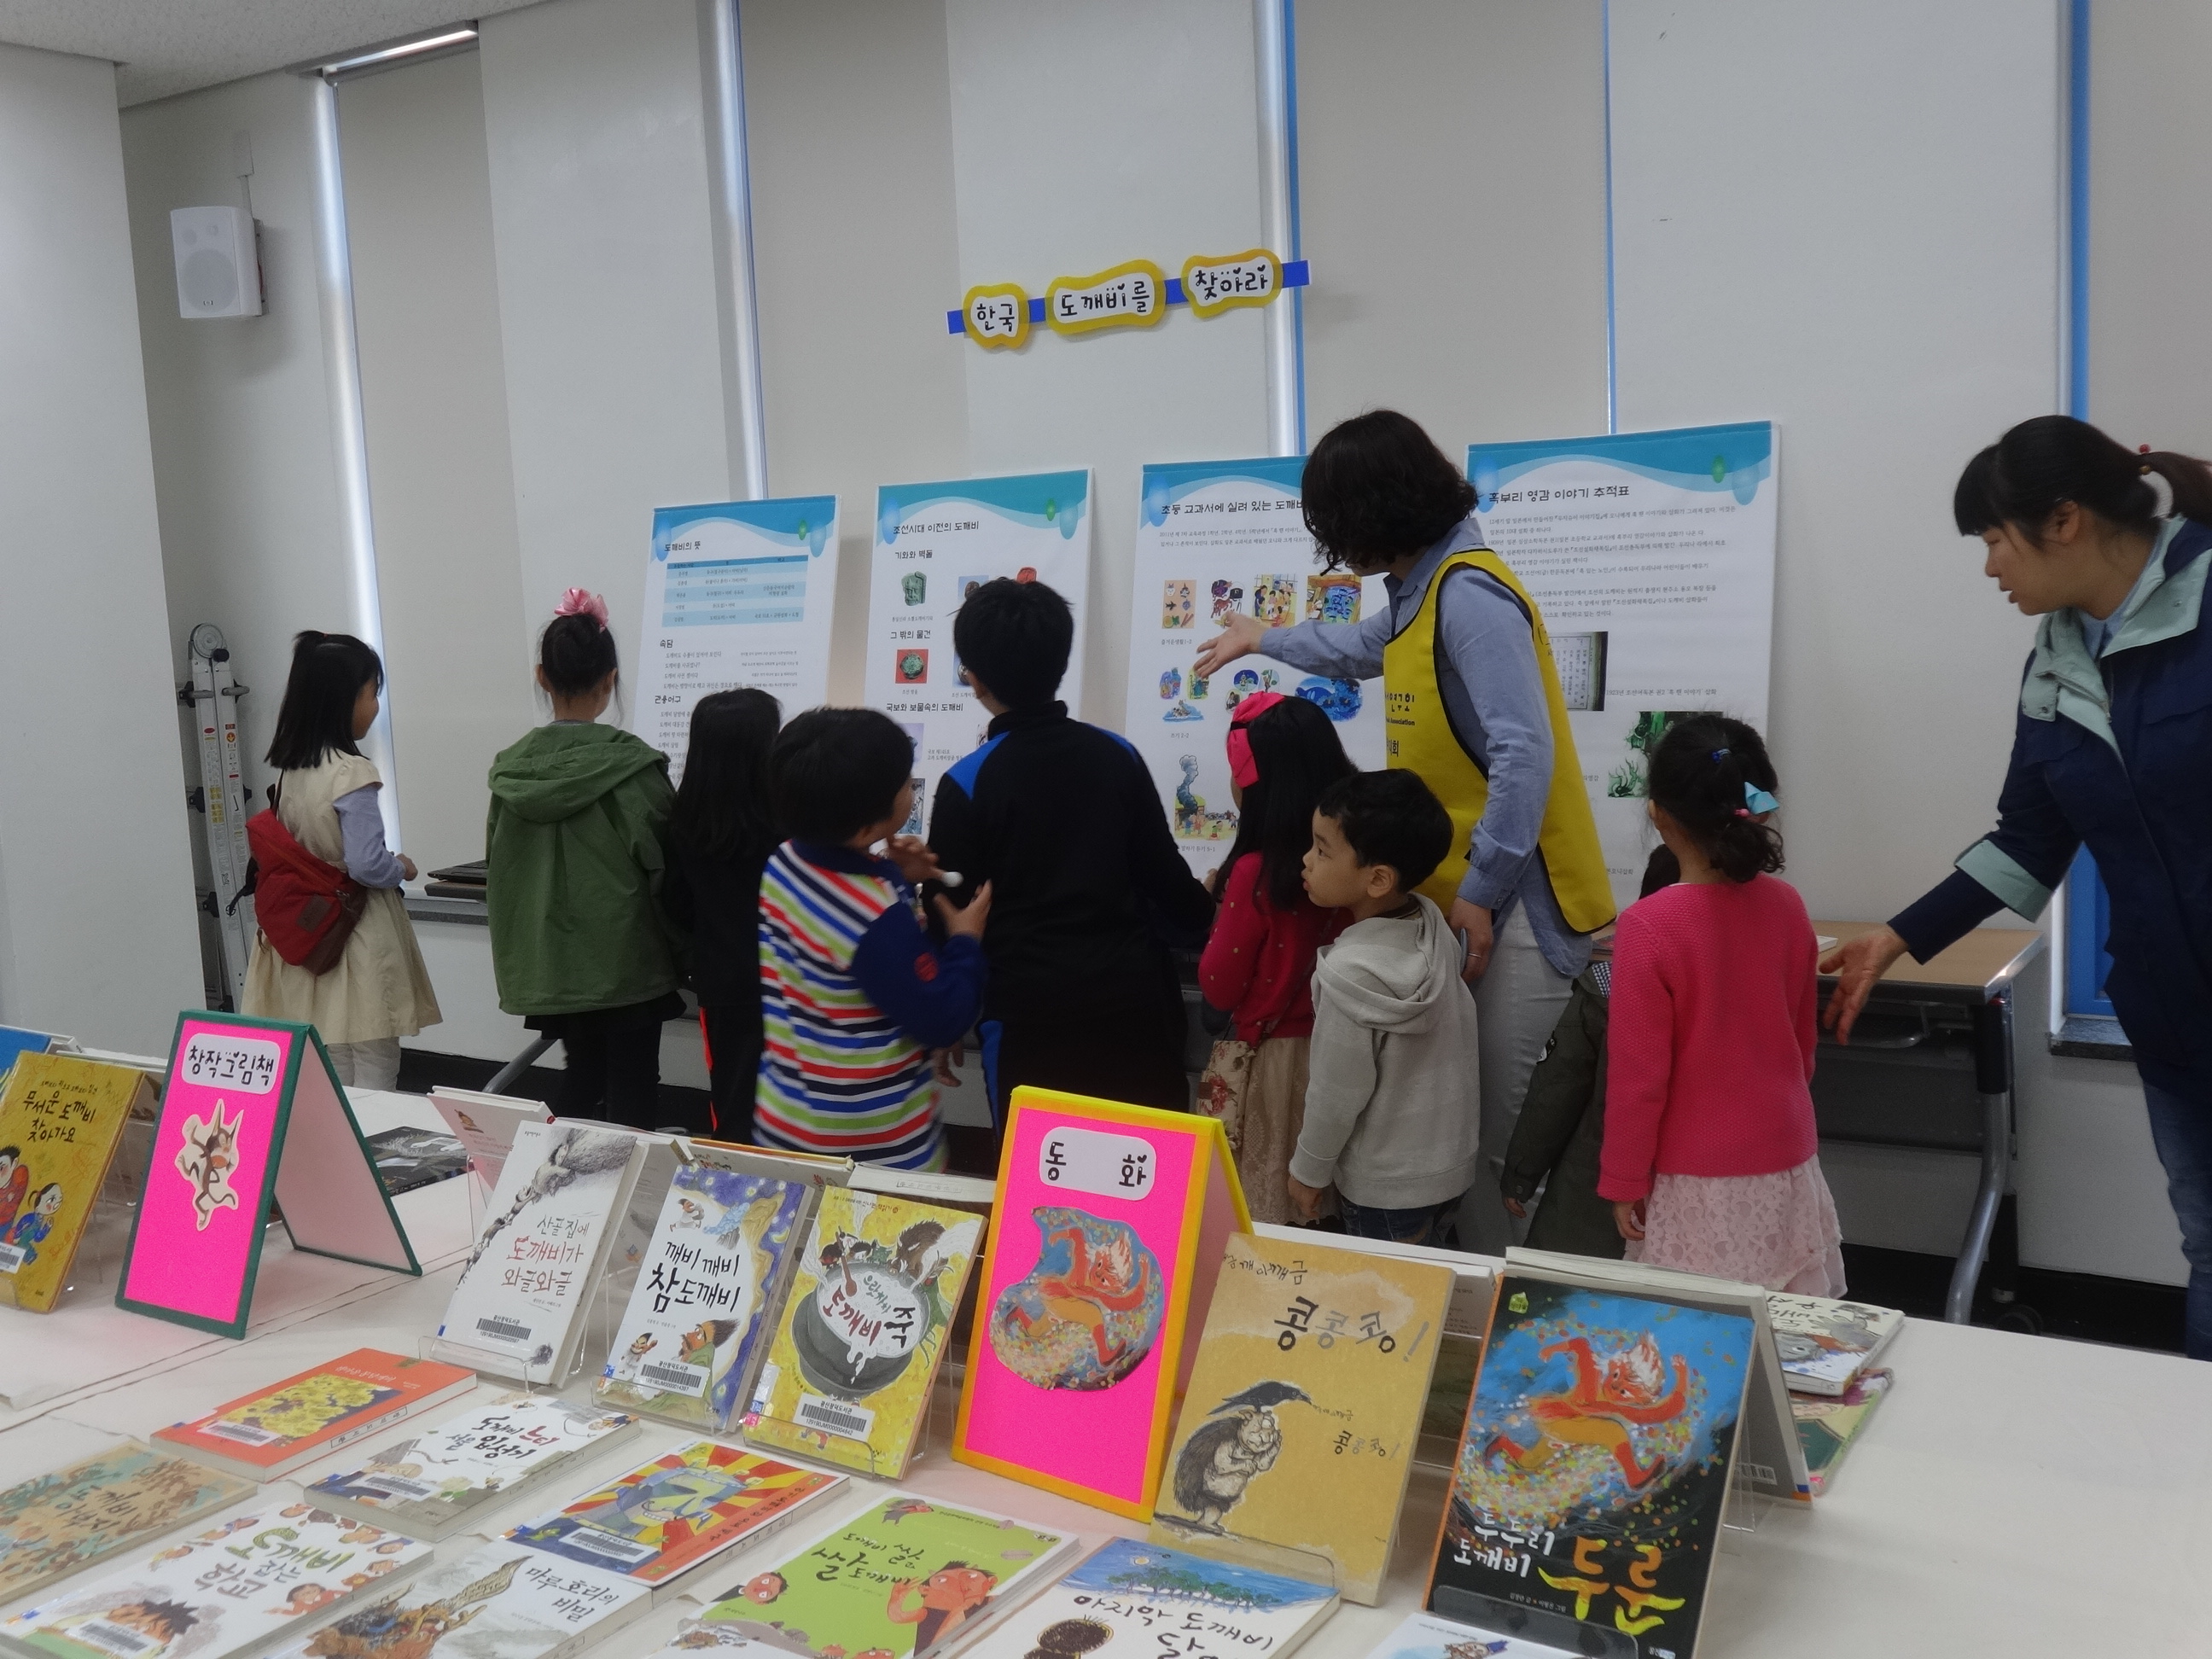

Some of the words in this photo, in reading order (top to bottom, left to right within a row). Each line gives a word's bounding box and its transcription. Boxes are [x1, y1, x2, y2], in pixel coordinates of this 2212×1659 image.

[975, 302, 1016, 332] 한국
[1059, 280, 1150, 317] 도깨비를
[1195, 263, 1269, 300] 찾아라
[1161, 504, 1181, 515] 초등
[1184, 502, 1224, 514] 교과서에
[1227, 502, 1248, 513] 실려
[1251, 500, 1272, 512] 있는
[1488, 492, 1522, 504] 혹부리
[1527, 489, 1550, 502] 영감
[1554, 487, 1589, 499] 이야기
[1593, 485, 1629, 498] 추적표
[893, 523, 925, 535] 조선시대
[927, 521, 952, 533] 이전의
[954, 521, 980, 533] 도깨비
[665, 542, 692, 553] 도깨비의
[694, 540, 701, 550] 뜻
[894, 550, 917, 560] 기와와
[918, 550, 933, 560] 벽돌
[659, 639, 673, 649] 속담
[899, 631, 914, 639] 밖의
[917, 630, 931, 639] 물건
[655, 695, 681, 704] 관용어구
[886, 703, 907, 712] 국보와
[910, 703, 939, 712] 보물속의
[940, 703, 963, 712] 도깨비
[188, 1044, 274, 1087] 창작그림책
[23, 1090, 60, 1114] 무서운
[58, 1100, 96, 1124] 도깨비
[26, 1116, 76, 1143] 찾아가요
[506, 1235, 585, 1265] 도깨비가
[665, 1241, 701, 1271] 깨비
[701, 1254, 740, 1278] 깨비
[501, 1266, 573, 1296] 와글와글
[863, 1275, 892, 1314] 으랏차차
[822, 1285, 882, 1347] 도깨비
[883, 1307, 916, 1348] 죽
[471, 1416, 525, 1435] 도깨비
[518, 1425, 561, 1447] 느티
[445, 1434, 476, 1451] 서울
[474, 1435, 537, 1459] 입성기
[842, 1533, 888, 1551] 도깨비
[1474, 1511, 1556, 1557] 두두리
[224, 1526, 355, 1574] 도깨비
[1453, 1538, 1532, 1578] 도깨비
[253, 1559, 302, 1583] 잡는
[551, 1598, 596, 1623] 비밀
[1179, 1612, 1273, 1650] 도깨비
